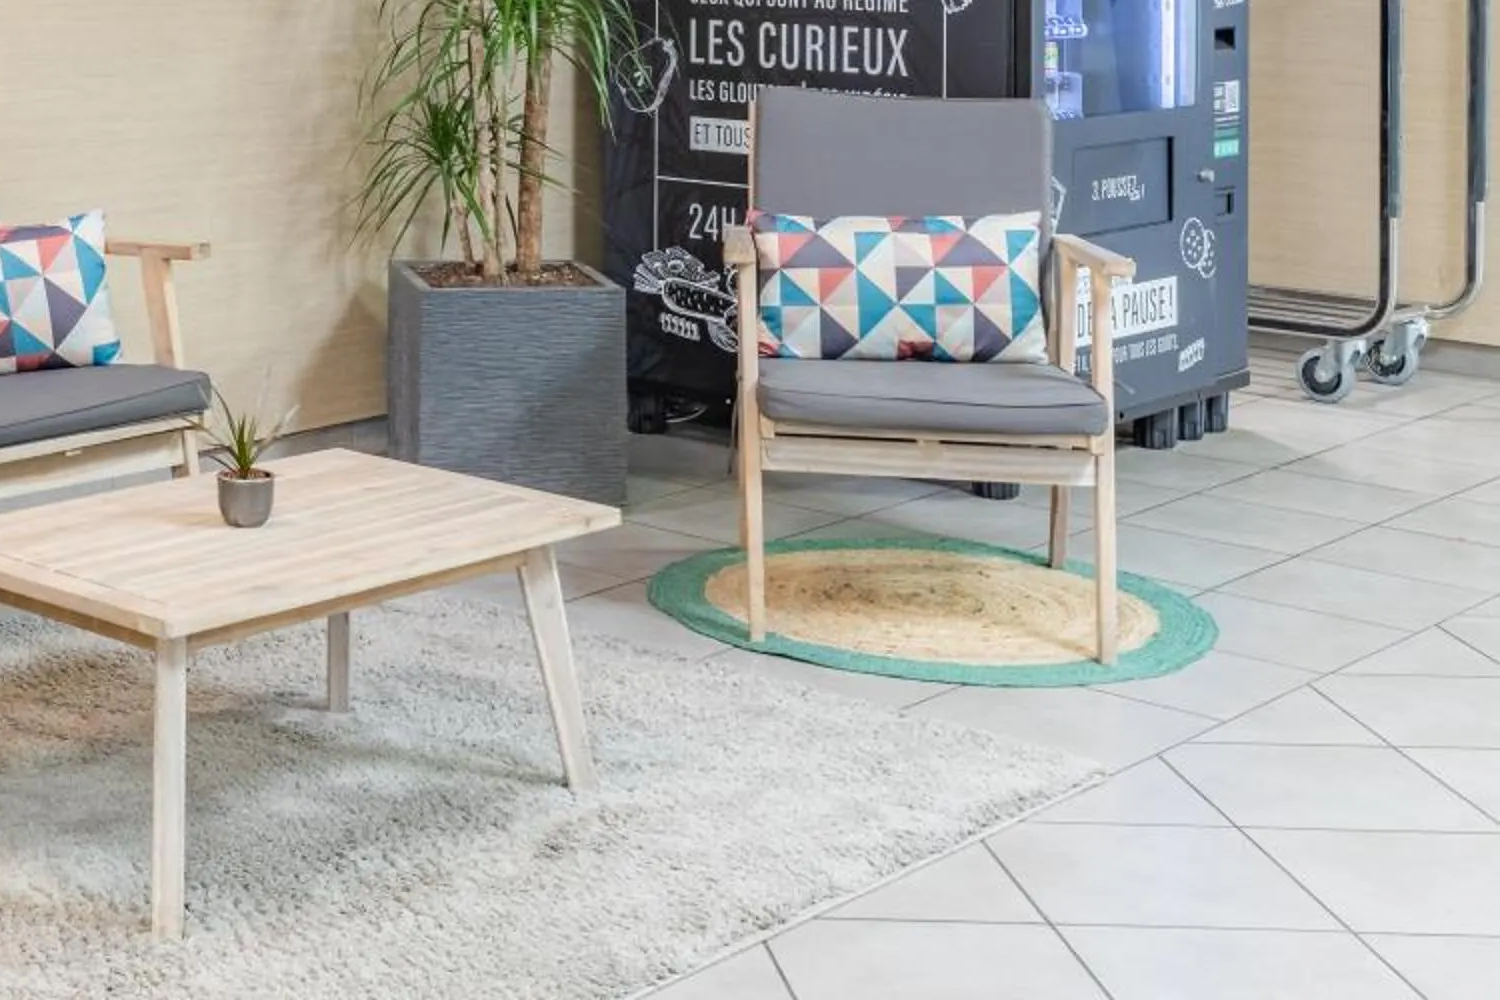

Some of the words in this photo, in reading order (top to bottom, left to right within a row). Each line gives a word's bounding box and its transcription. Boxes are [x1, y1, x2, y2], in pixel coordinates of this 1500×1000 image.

[689, 18, 745, 67] LES
[758, 21, 910, 78] CURIEUX
[689, 79, 715, 102] LES
[719, 81, 766, 105] GLOU
[694, 124, 711, 145] ET
[716, 125, 751, 149] TOUS
